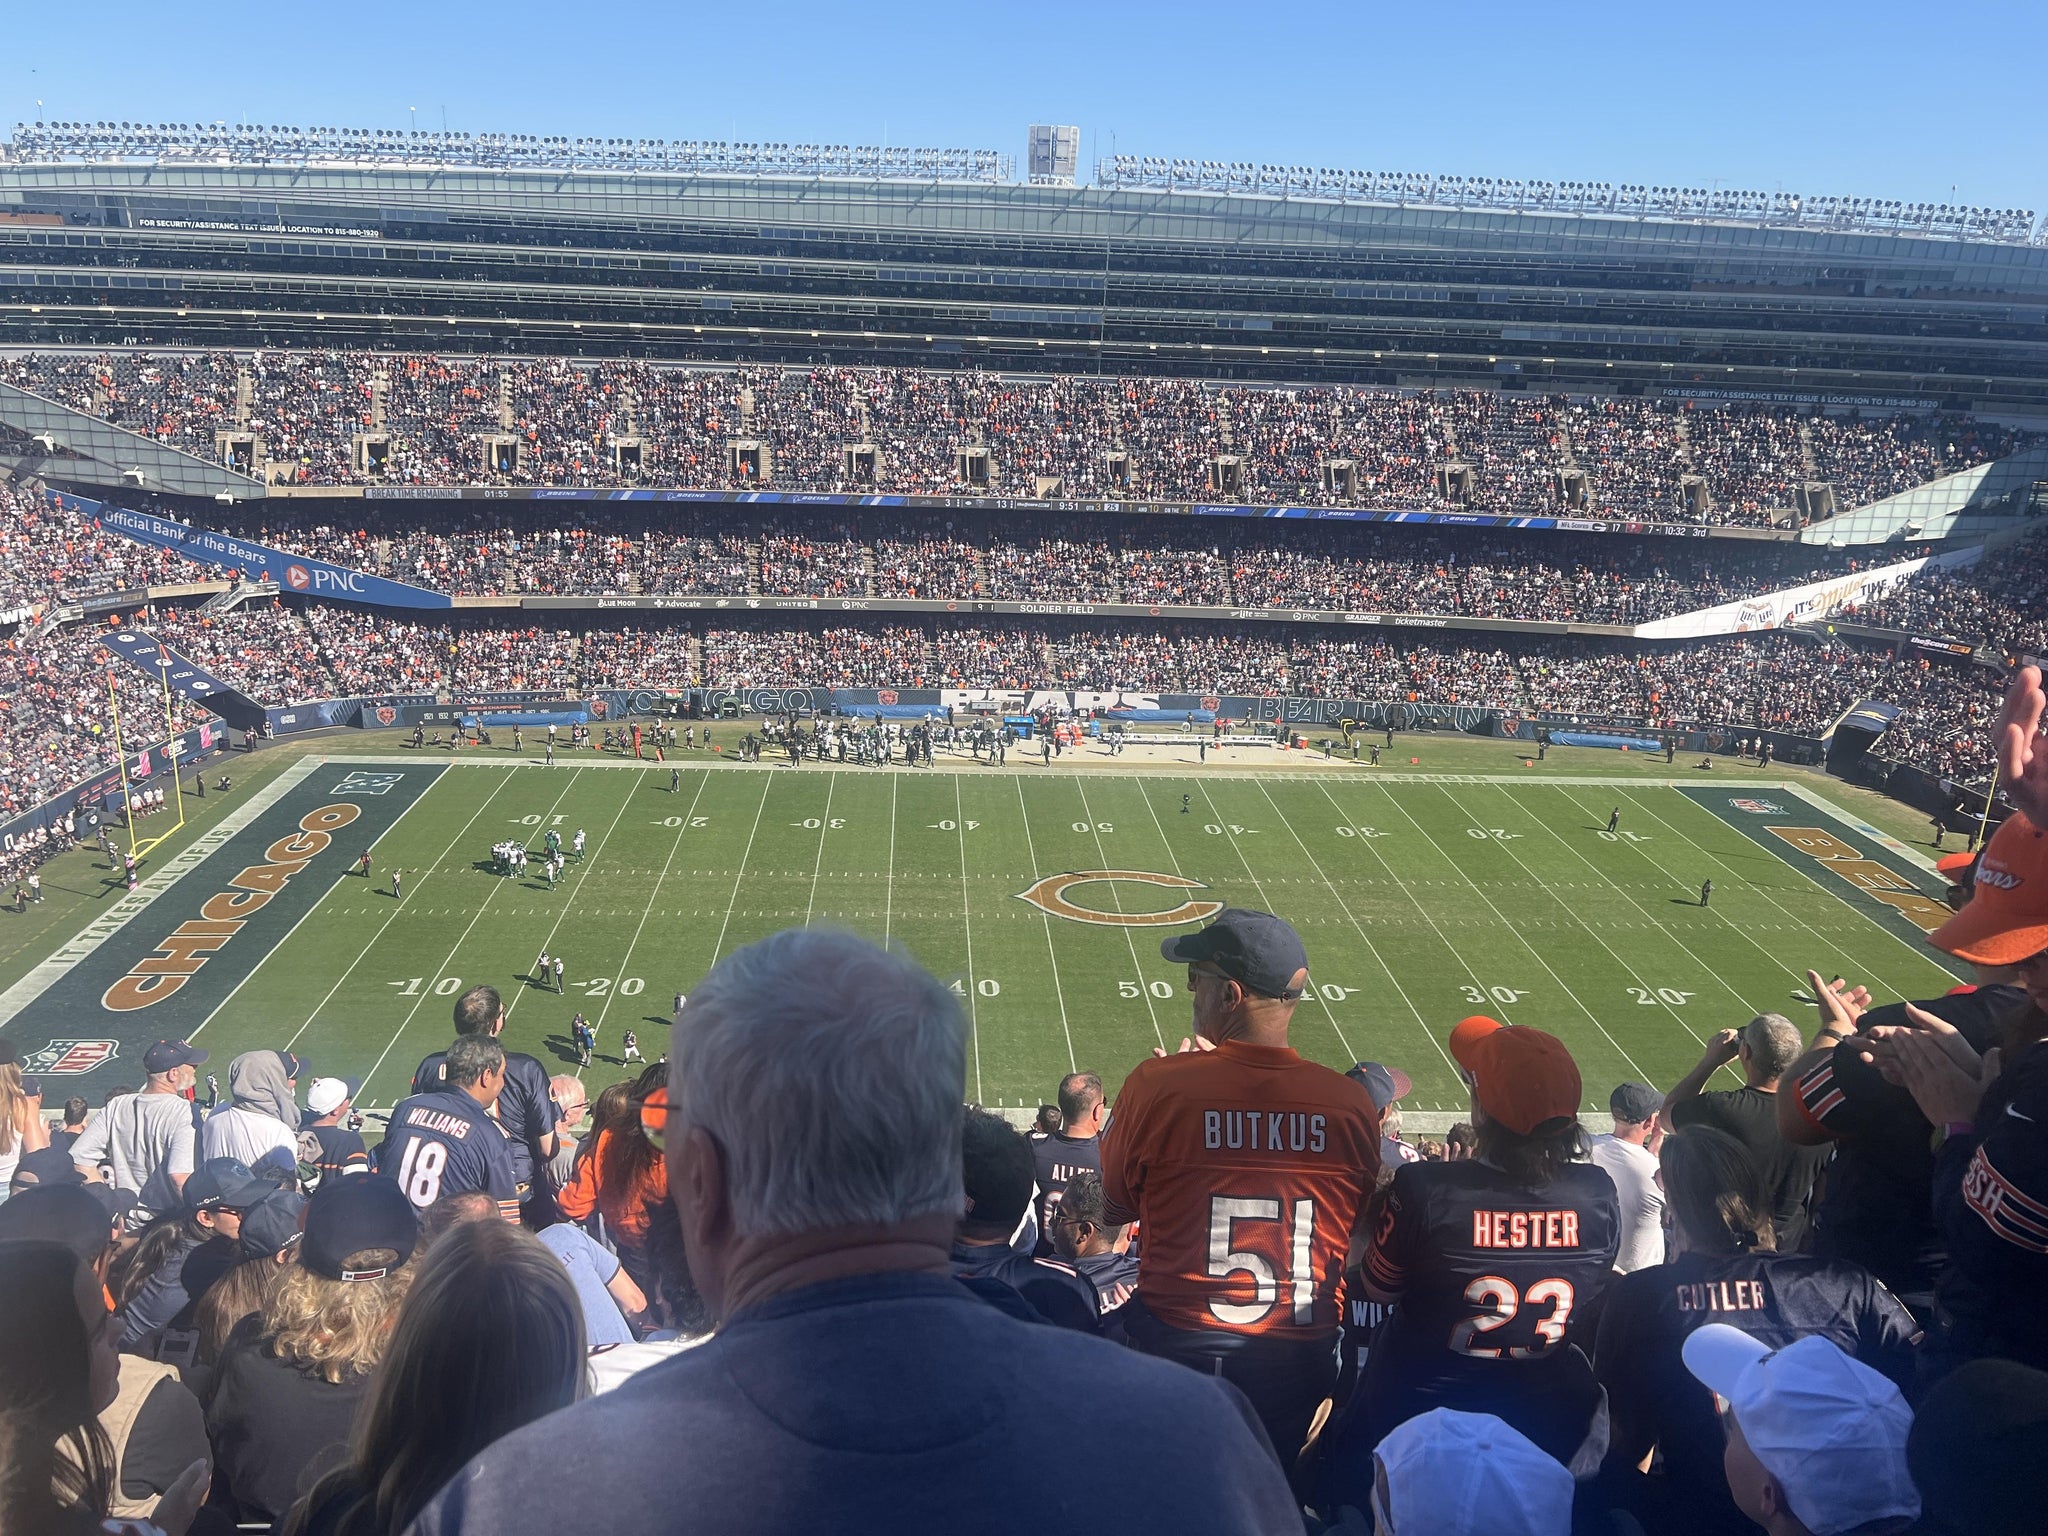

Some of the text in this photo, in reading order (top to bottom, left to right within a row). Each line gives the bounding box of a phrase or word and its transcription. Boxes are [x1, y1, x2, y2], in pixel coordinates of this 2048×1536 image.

[139, 218, 155, 228] FOR
[156, 219, 239, 230] SECURITY/ASSISTANCE
[240, 223, 258, 231] TEXT
[287, 225, 323, 234] LOCATION
[324, 227, 334, 235] TO
[1662, 388, 1680, 396] FOR
[1681, 388, 1771, 401] SECURITY/ASSISTANCE
[1773, 392, 1794, 402] TEXT
[1796, 394, 1819, 403] ISSUE
[1827, 395, 1870, 406] LOCATION
[1871, 397, 1883, 406] TO
[372, 489, 458, 499] BREAK TIME REMAINING
[484, 490, 509, 498] 01:55
[945, 499, 951, 507] 3
[996, 500, 1008, 509] 13
[1059, 502, 1079, 511] 9:51
[1096, 503, 1101, 512] 3
[1150, 504, 1159, 512] 10
[1183, 506, 1189, 514] 4
[1572, 522, 1590, 530] Scores
[1612, 524, 1620, 532] 17
[1664, 526, 1686, 536] 10:32
[1692, 528, 1706, 538] 3rd
[104, 510, 267, 565] Official Bank of the Bears
[312, 569, 366, 593] PNC
[1794, 599, 1814, 615] IT'S
[1812, 574, 1868, 616] Miller
[84, 596, 122, 608] theScore
[598, 598, 615, 608] BLUE
[665, 600, 701, 608] Advocate
[851, 600, 869, 609] PNC
[1020, 604, 1094, 614] SOLDIER FIELD
[1302, 613, 1320, 621] PNC
[1345, 614, 1381, 622] GRAINGER
[1395, 617, 1447, 628] ticketmaster
[1910, 636, 1950, 648] theScore
[1258, 697, 1344, 722] BEAR
[424, 712, 434, 720] 1921
[521, 814, 568, 826] 10
[664, 816, 710, 828] 20
[803, 818, 847, 829] 30
[939, 820, 980, 831] 40
[1072, 822, 1114, 833] 50
[1204, 824, 1245, 835] 40
[1336, 826, 1379, 838] 30
[1466, 828, 1516, 840] 20
[48, 828, 234, 963] IT TAKES ALL OF US
[100, 803, 362, 1012] CHICAGO
[398, 977, 462, 996] 10
[585, 977, 645, 996] 20
[1118, 980, 1173, 999] 50
[1460, 985, 1519, 1003] 30
[1626, 987, 1686, 1006] 20
[52, 1043, 110, 1070] NFL
[407, 1108, 470, 1140] WILLIAMS
[1204, 1110, 1326, 1153] BUTKUS
[398, 1136, 448, 1207] 18
[1473, 1210, 1579, 1249] HESTER
[1208, 1194, 1314, 1326] 51
[1676, 1280, 1764, 1312] CUTLER
[1449, 1275, 1574, 1360] 23
